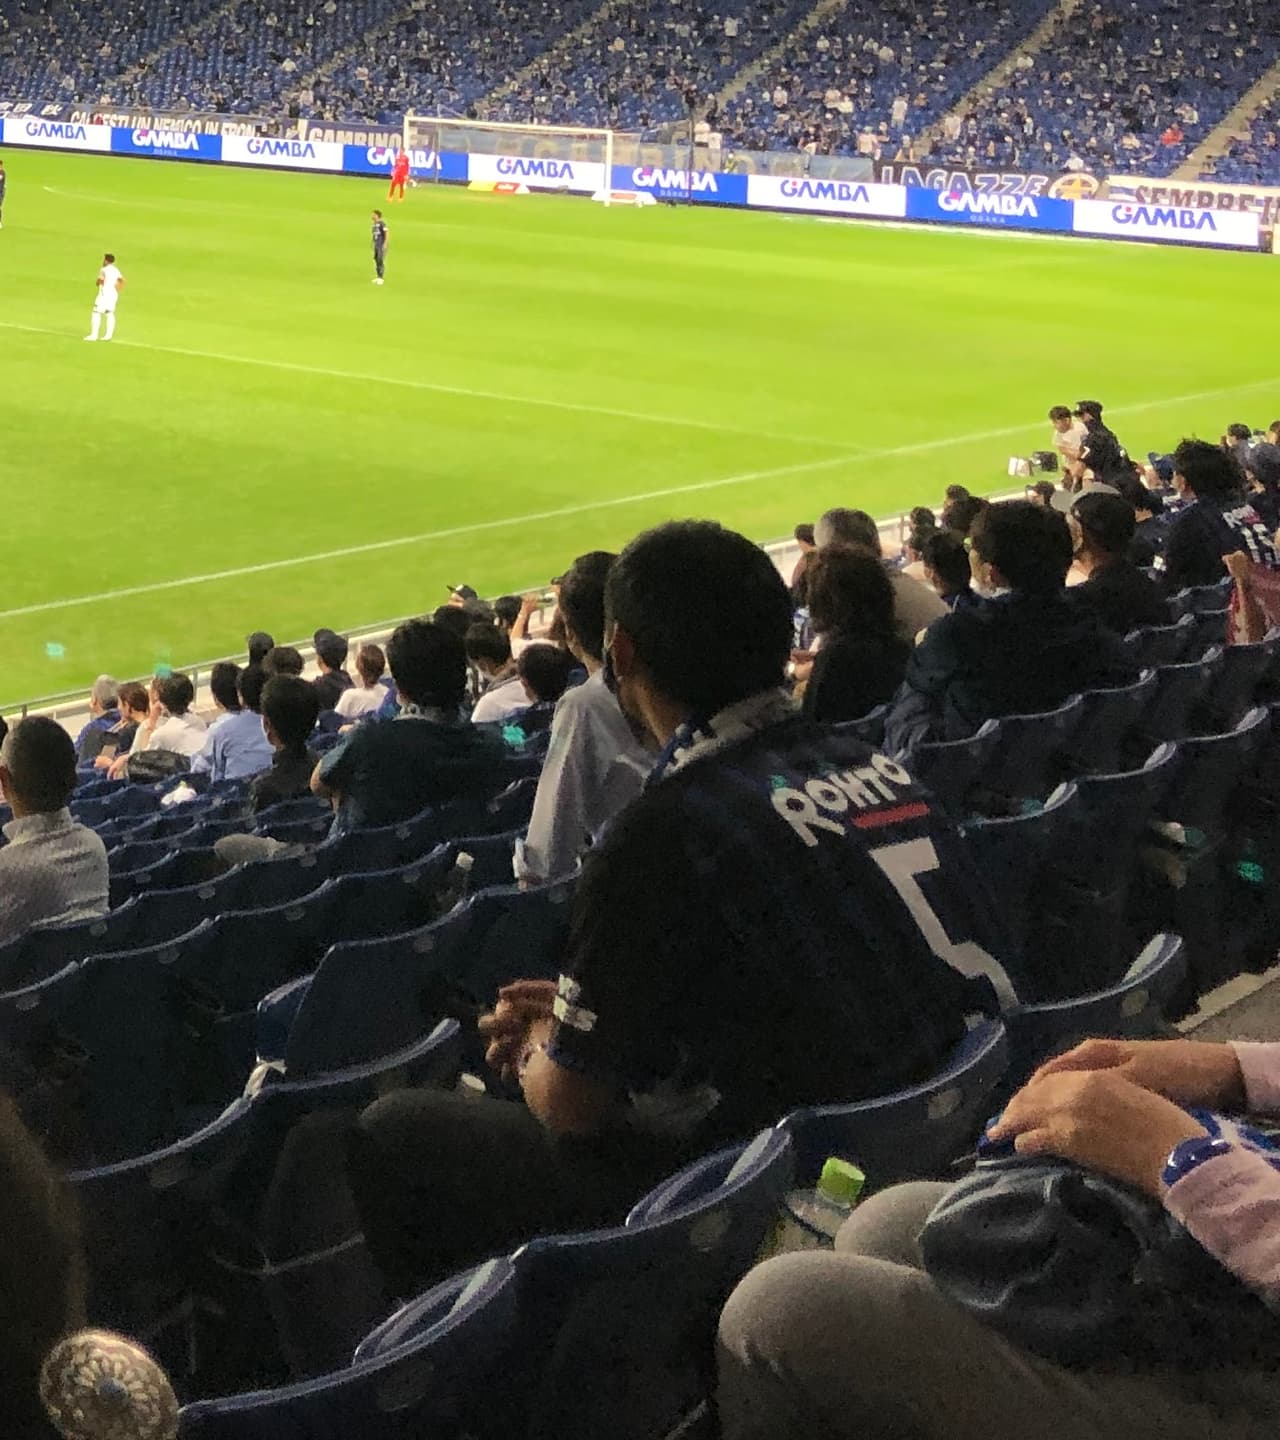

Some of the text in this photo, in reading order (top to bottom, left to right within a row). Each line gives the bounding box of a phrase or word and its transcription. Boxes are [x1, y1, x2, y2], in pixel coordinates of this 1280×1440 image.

[25, 120, 88, 141] GAMBA
[131, 128, 200, 151] GAMBA
[246, 138, 317, 159] GAMBA
[496, 157, 575, 181] GAMBA
[631, 166, 718, 193] GAMBA
[780, 178, 870, 203] GAMBA
[1134, 185, 1255, 213] SEMPRE
[937, 191, 1039, 219] GAMBA
[1111, 203, 1217, 231] GAMBA
[770, 752, 912, 848] ROHTO
